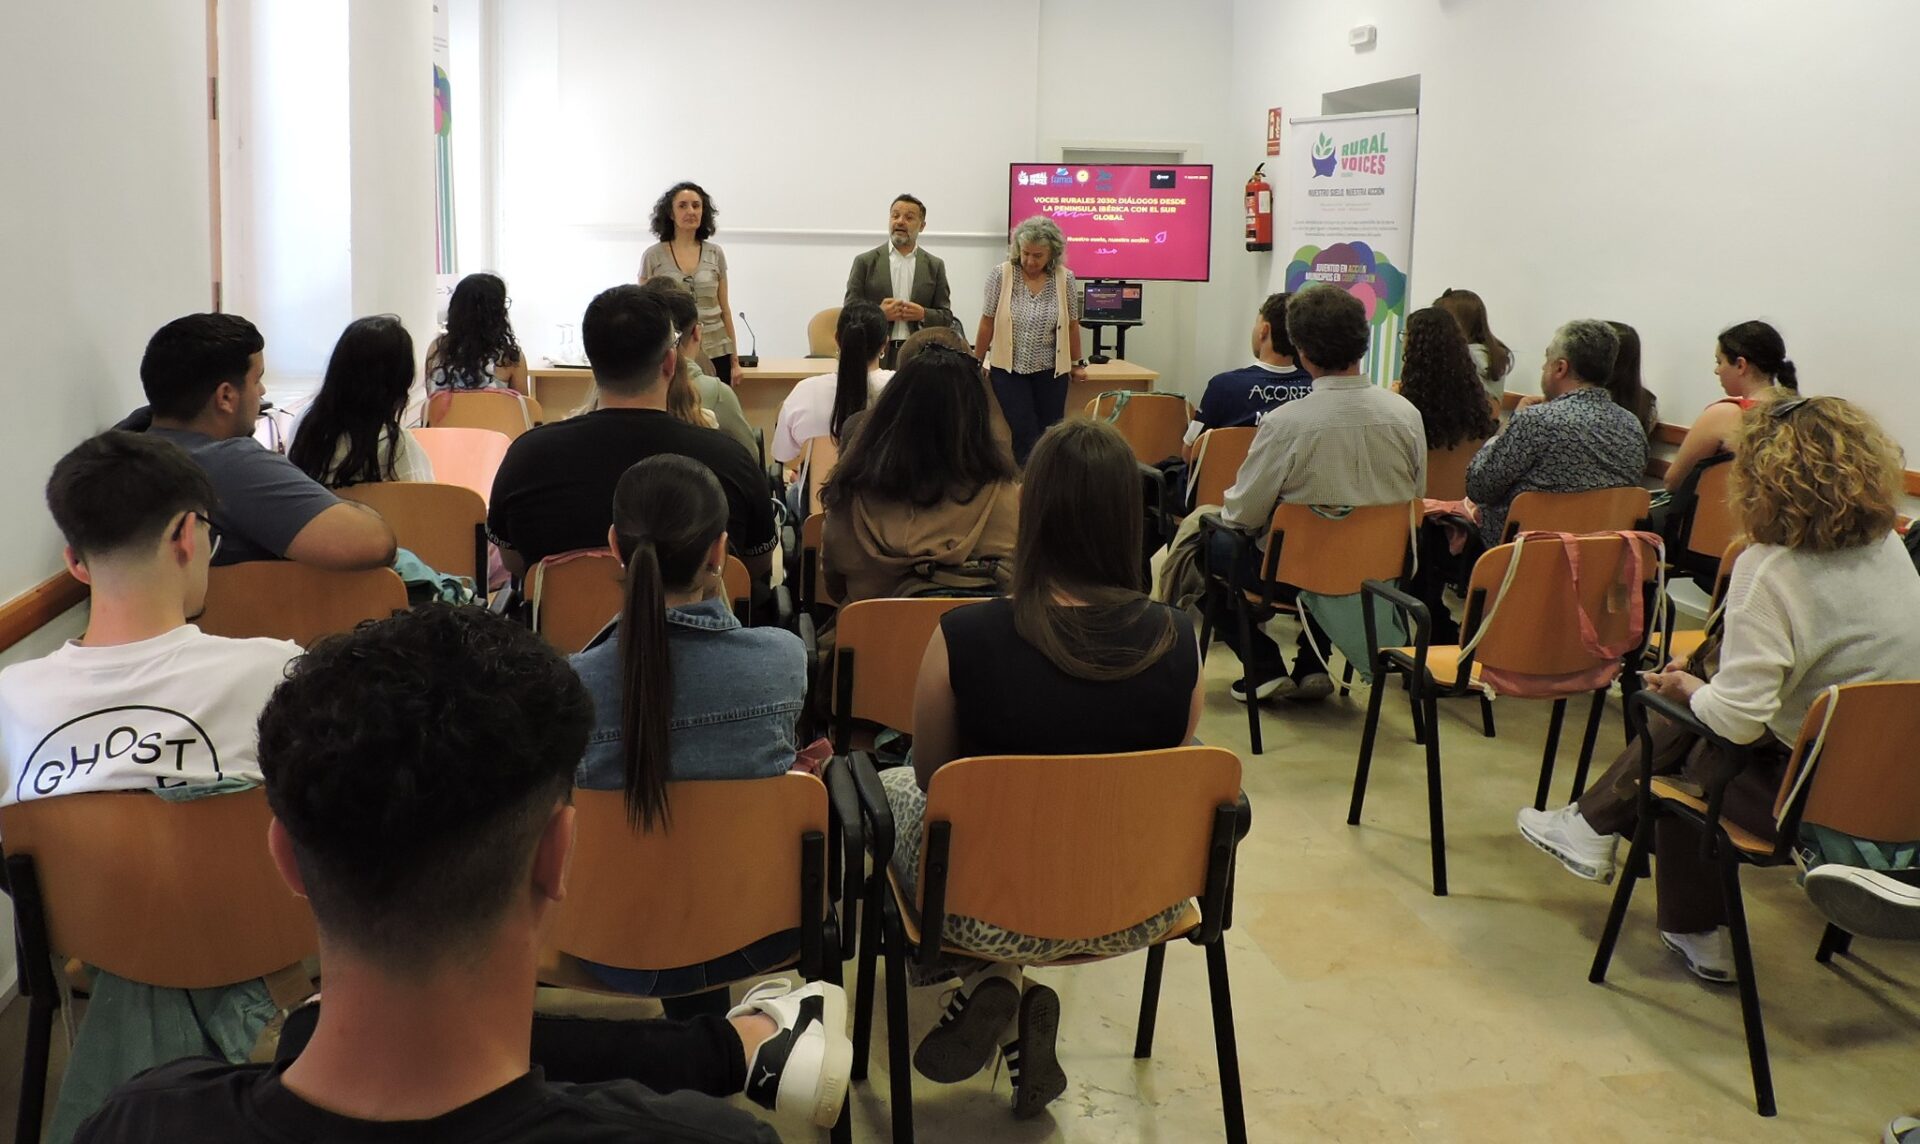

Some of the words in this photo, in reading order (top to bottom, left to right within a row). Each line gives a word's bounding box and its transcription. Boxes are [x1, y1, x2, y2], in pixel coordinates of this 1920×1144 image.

[1341, 131, 1389, 156] RURAL
[1341, 154, 1386, 176] VOICES
[1034, 196, 1059, 204] VOCES
[1060, 196, 1095, 204] RURALES
[1096, 196, 1117, 204] 2030:
[1118, 196, 1158, 205] DIÁLOGOS
[1159, 197, 1186, 205] DESDE
[1098, 204, 1129, 213] IBÉRICA
[1092, 213, 1125, 221] GLOBAL
[1316, 263, 1340, 273] JUVENTUD
[1340, 264, 1348, 273] EN
[1333, 272, 1341, 282] EN
[33, 725, 197, 795] GHOST
